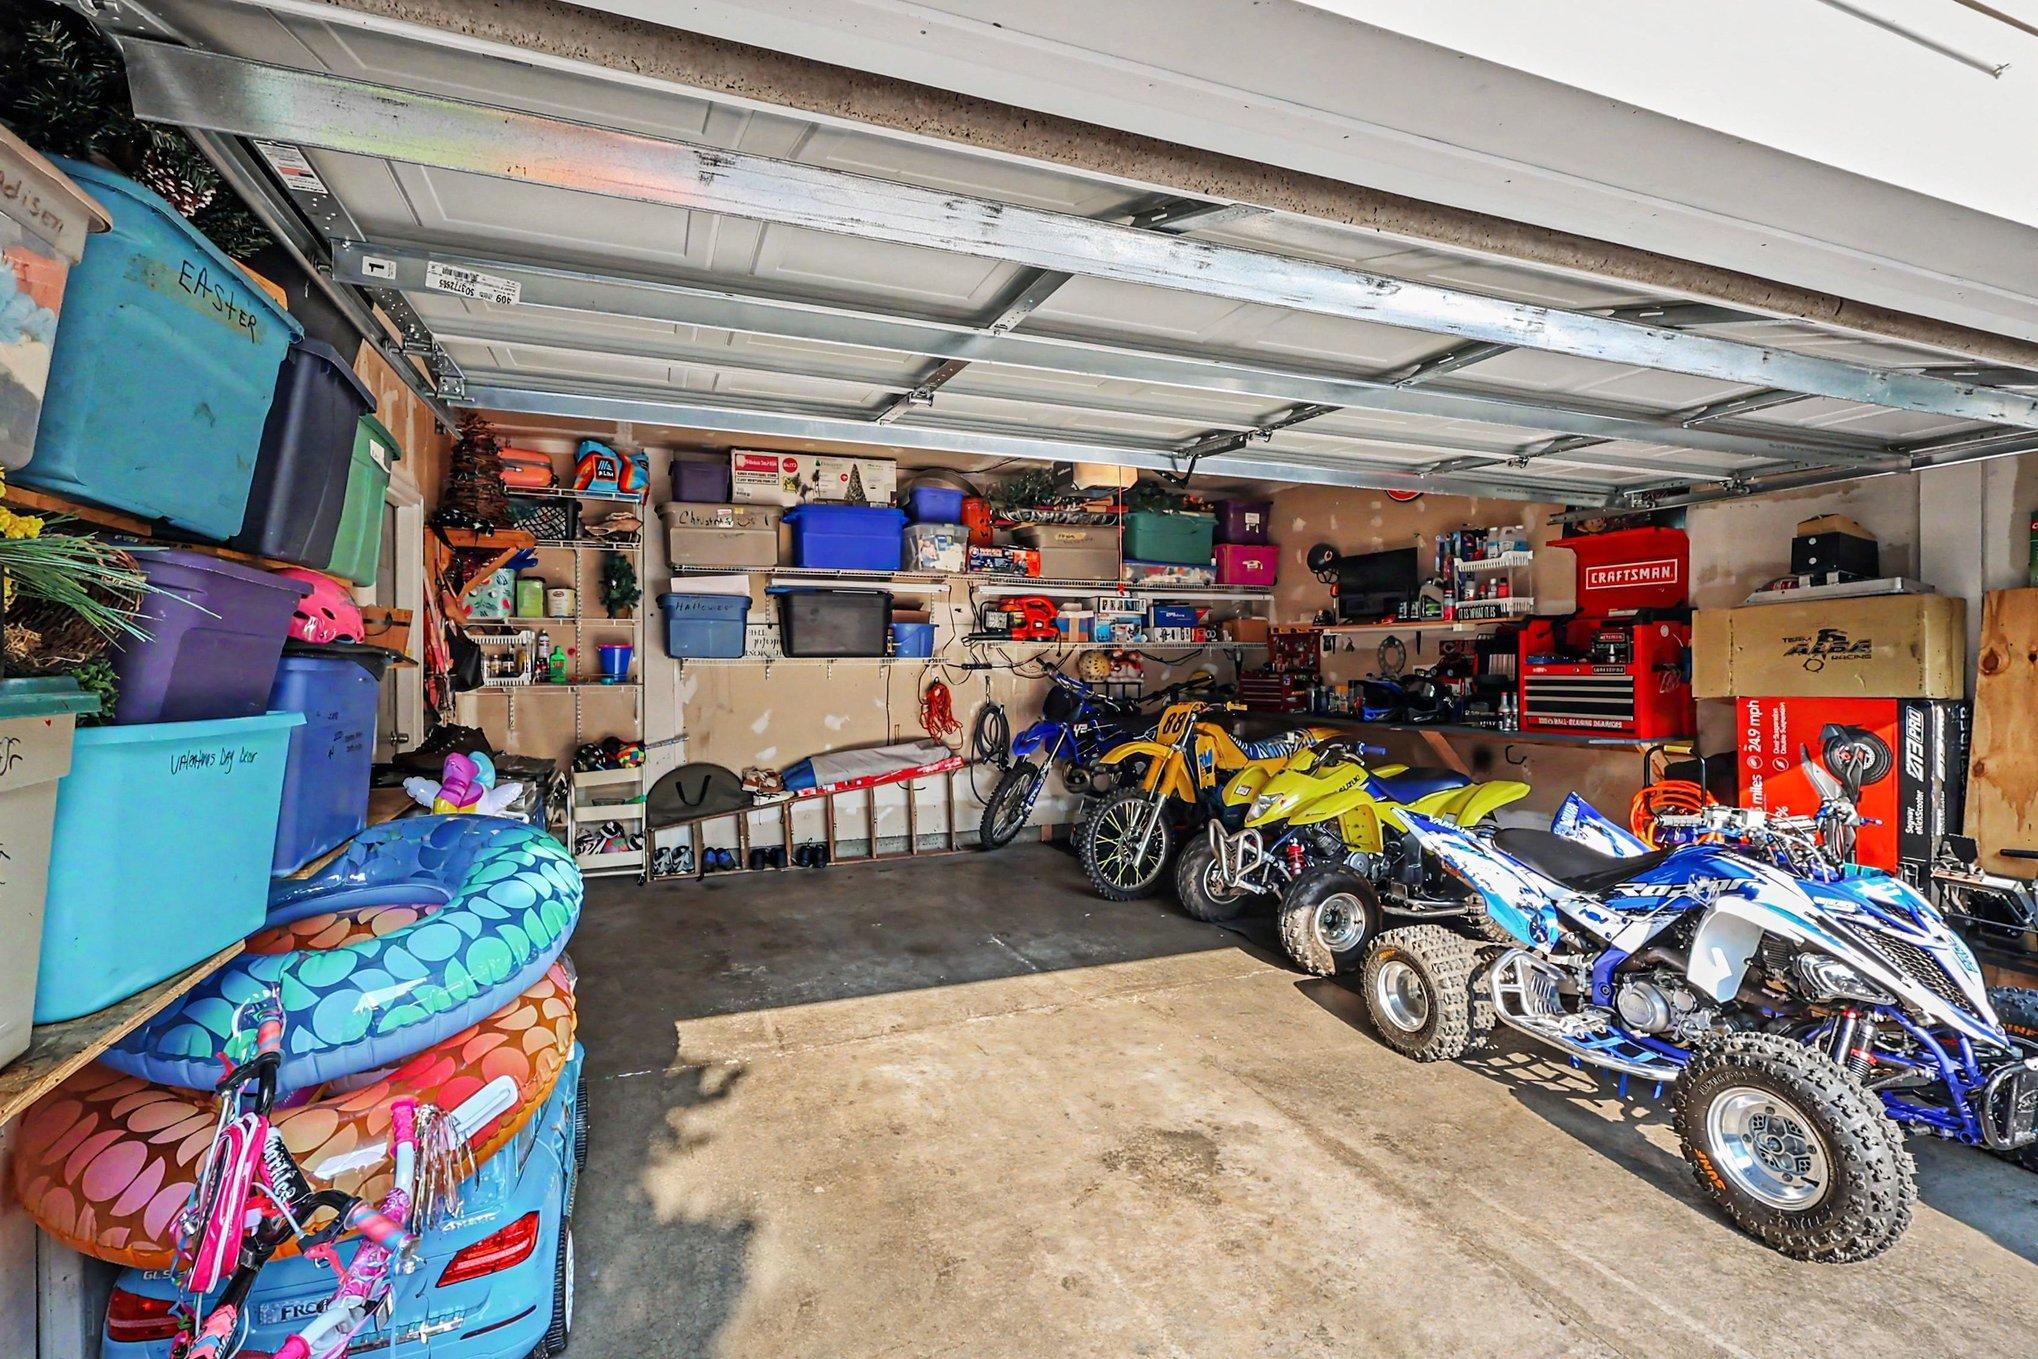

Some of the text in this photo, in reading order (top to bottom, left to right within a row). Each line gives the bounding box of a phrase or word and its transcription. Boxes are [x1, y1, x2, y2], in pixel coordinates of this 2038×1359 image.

[1591, 566, 1671, 584] CRAFTSMAN
[1747, 699, 1763, 753] 24.9 mph
[1750, 774, 1763, 805] miles
[1905, 806, 1915, 834] Segway
